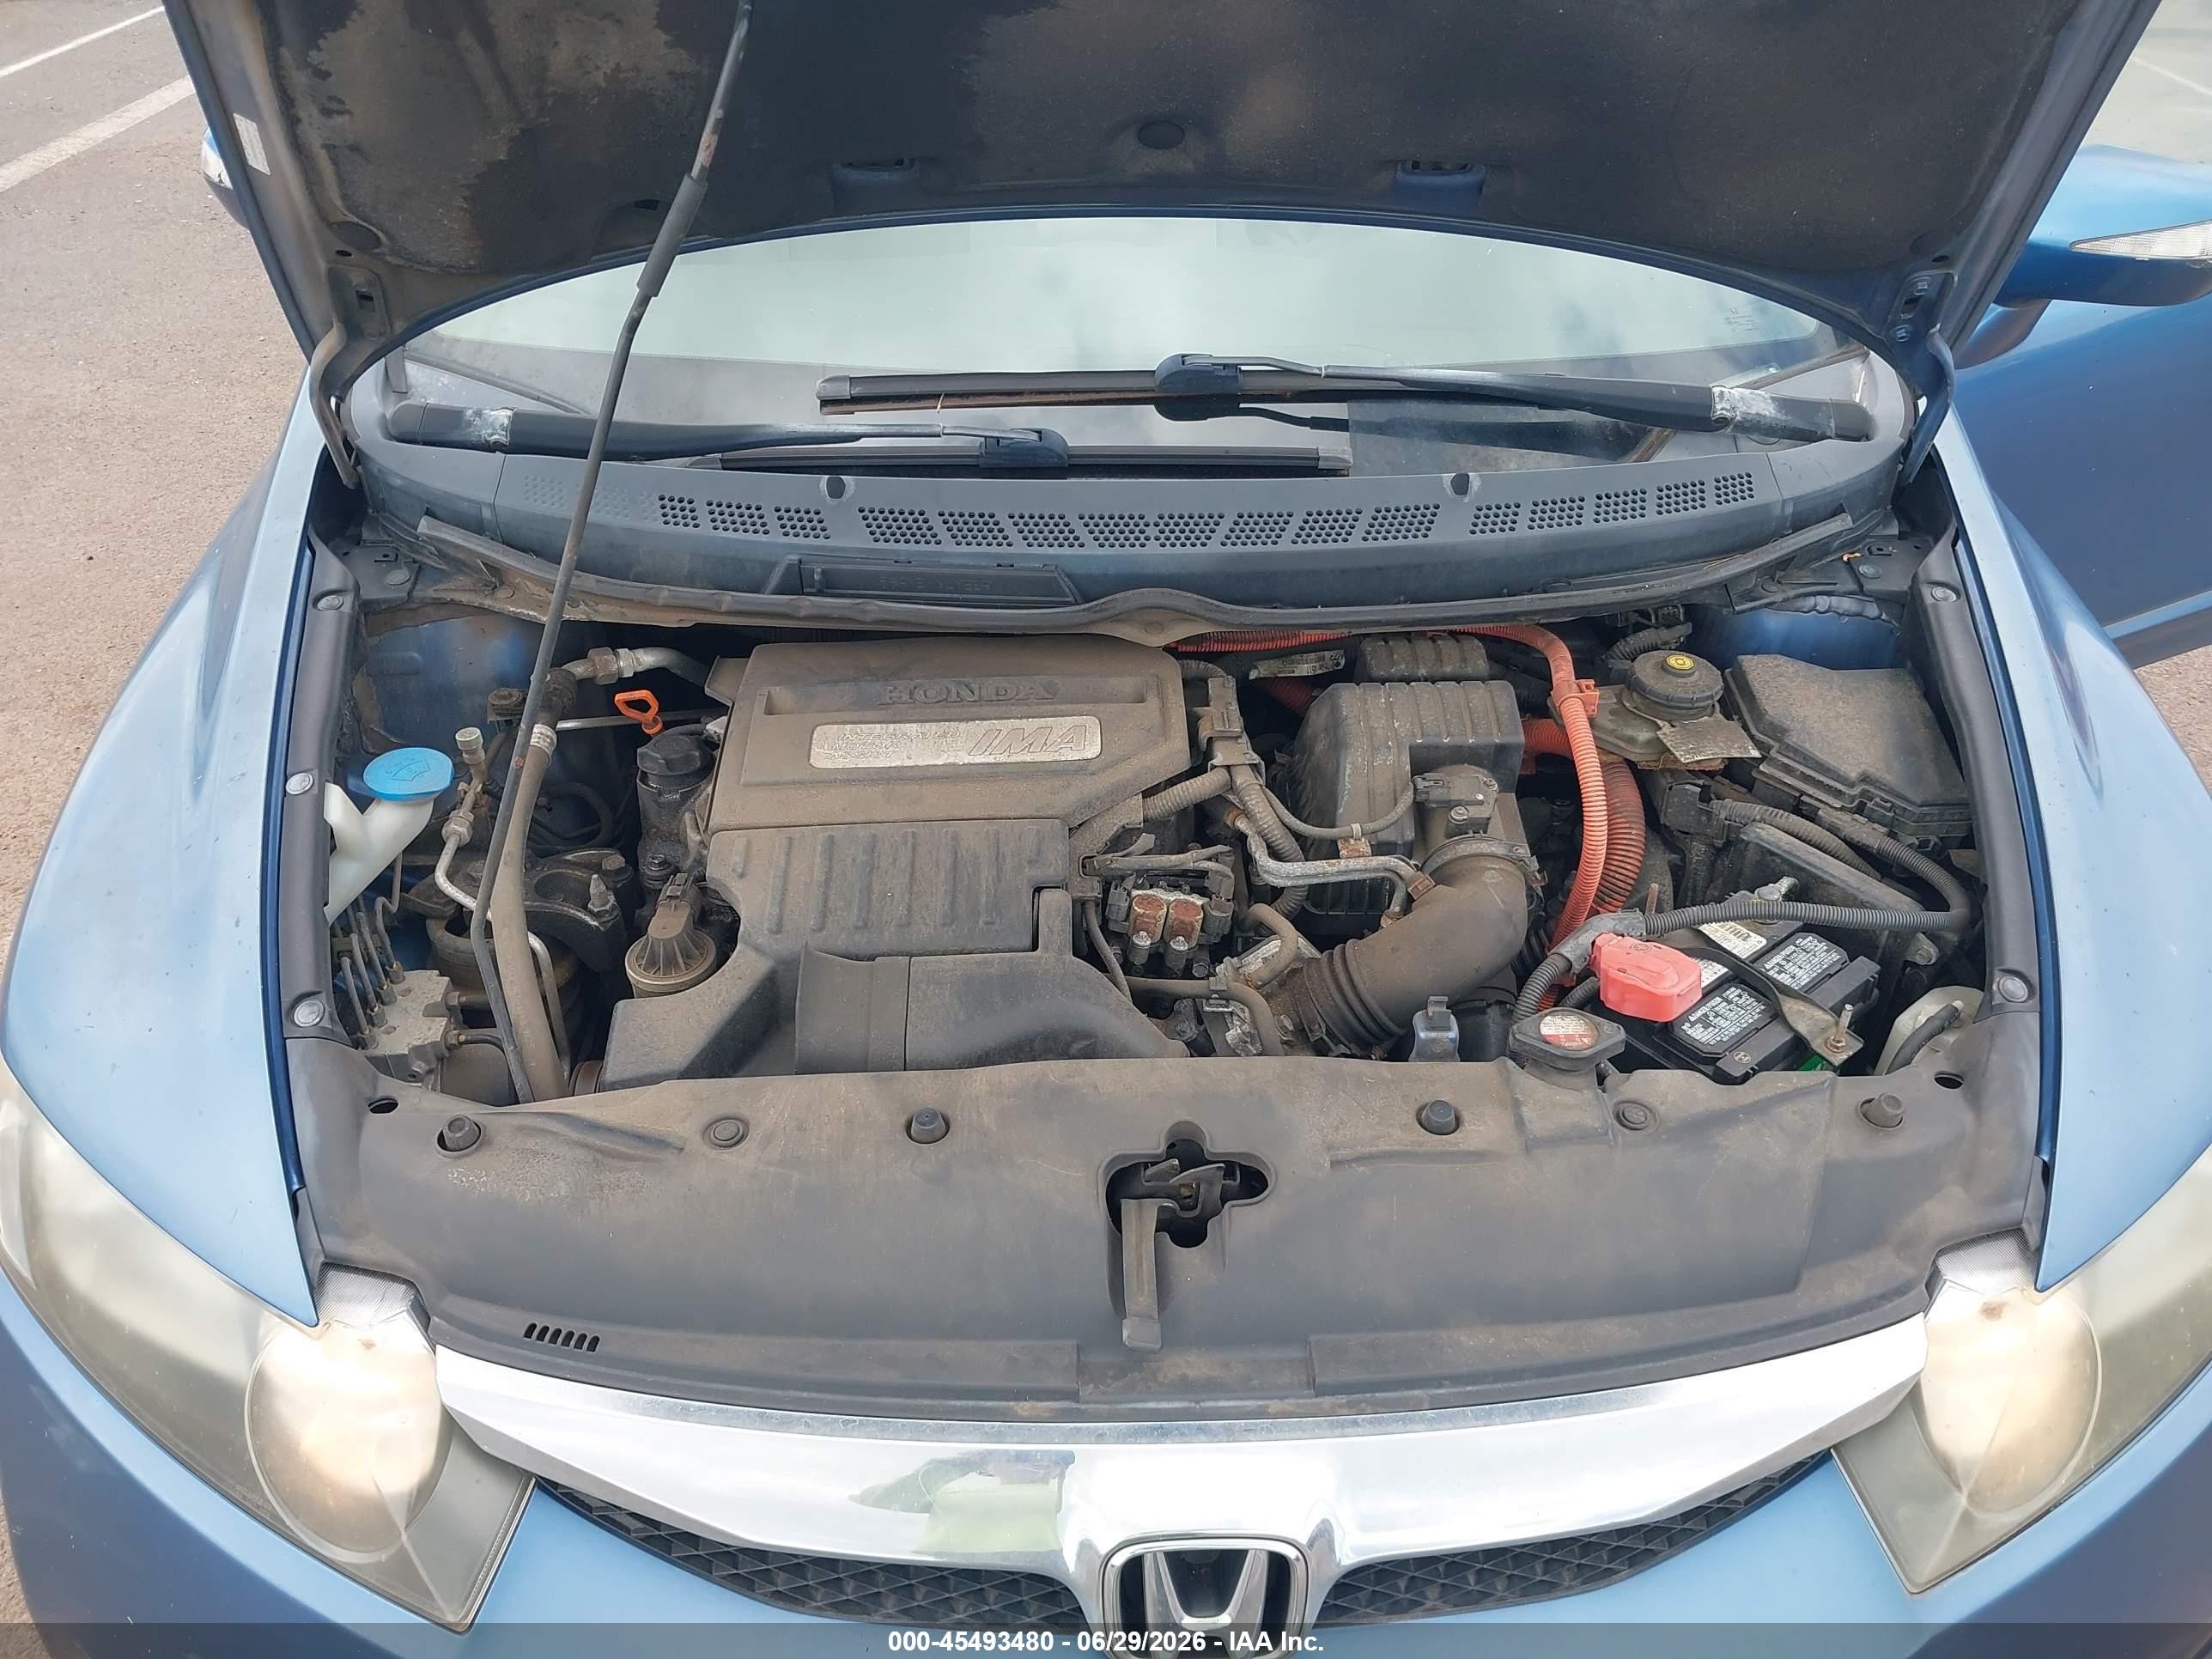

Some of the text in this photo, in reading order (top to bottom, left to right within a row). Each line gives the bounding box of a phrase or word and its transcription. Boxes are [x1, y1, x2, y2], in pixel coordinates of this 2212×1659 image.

[878, 678, 1059, 705] HONDA
[838, 731, 961, 741] INTEGRATED
[968, 726, 1087, 757] IMA
